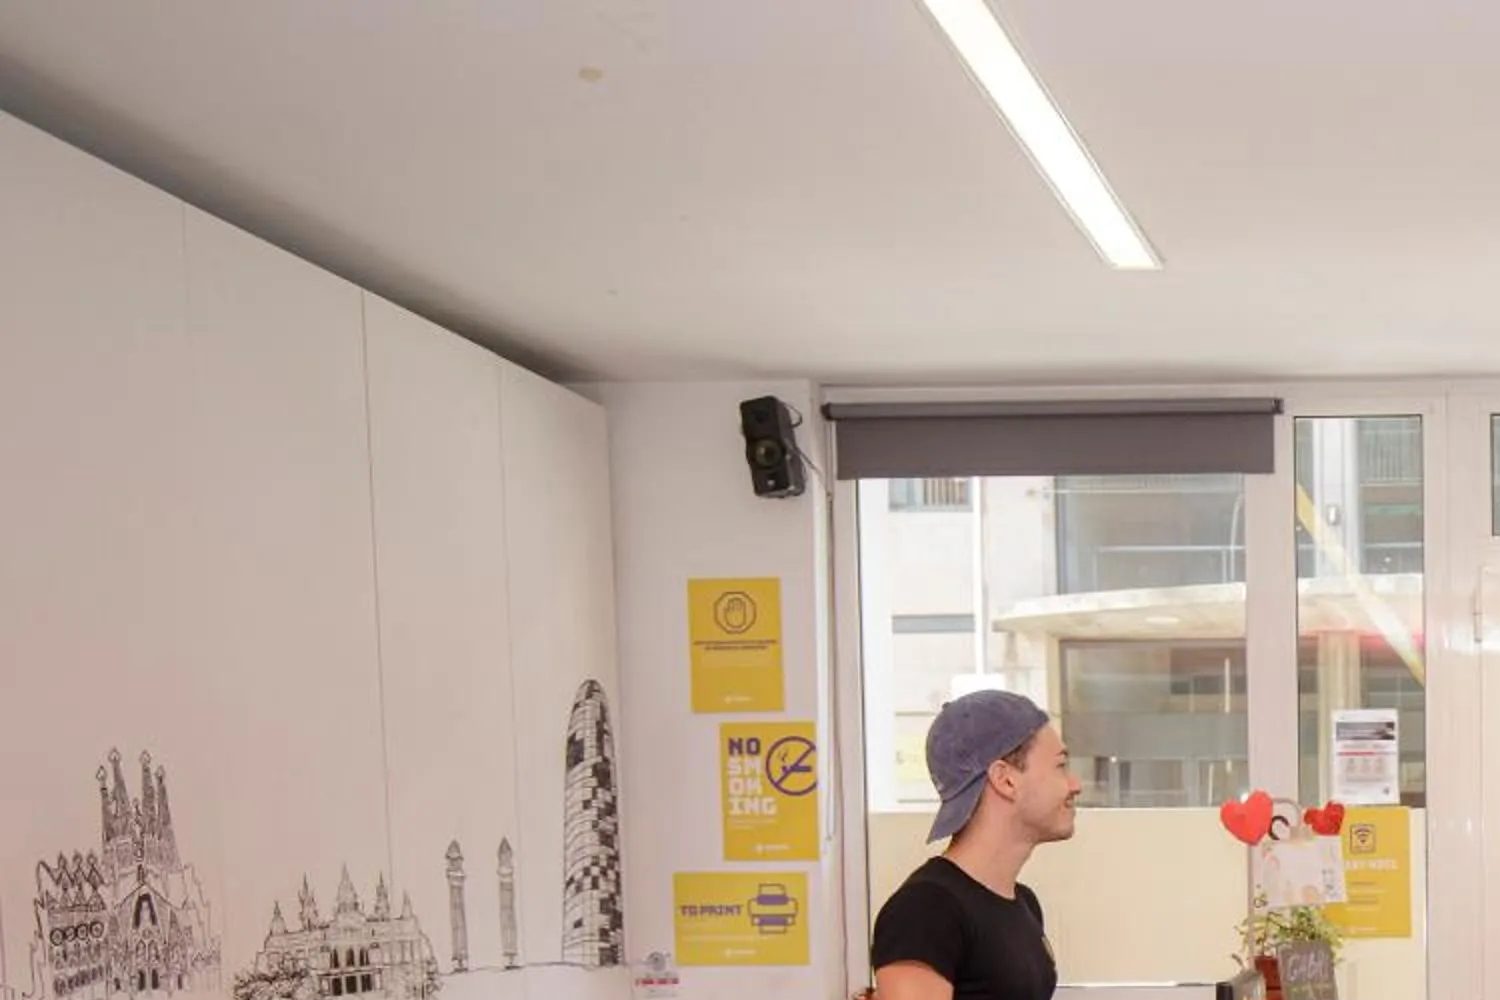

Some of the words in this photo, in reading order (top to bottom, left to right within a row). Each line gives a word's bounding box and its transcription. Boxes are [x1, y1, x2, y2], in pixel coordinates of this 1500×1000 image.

[728, 737, 761, 756] NO
[728, 757, 762, 776] SM
[728, 796, 778, 816] ING
[681, 904, 698, 917] TO
[700, 904, 742, 917] PRINT
